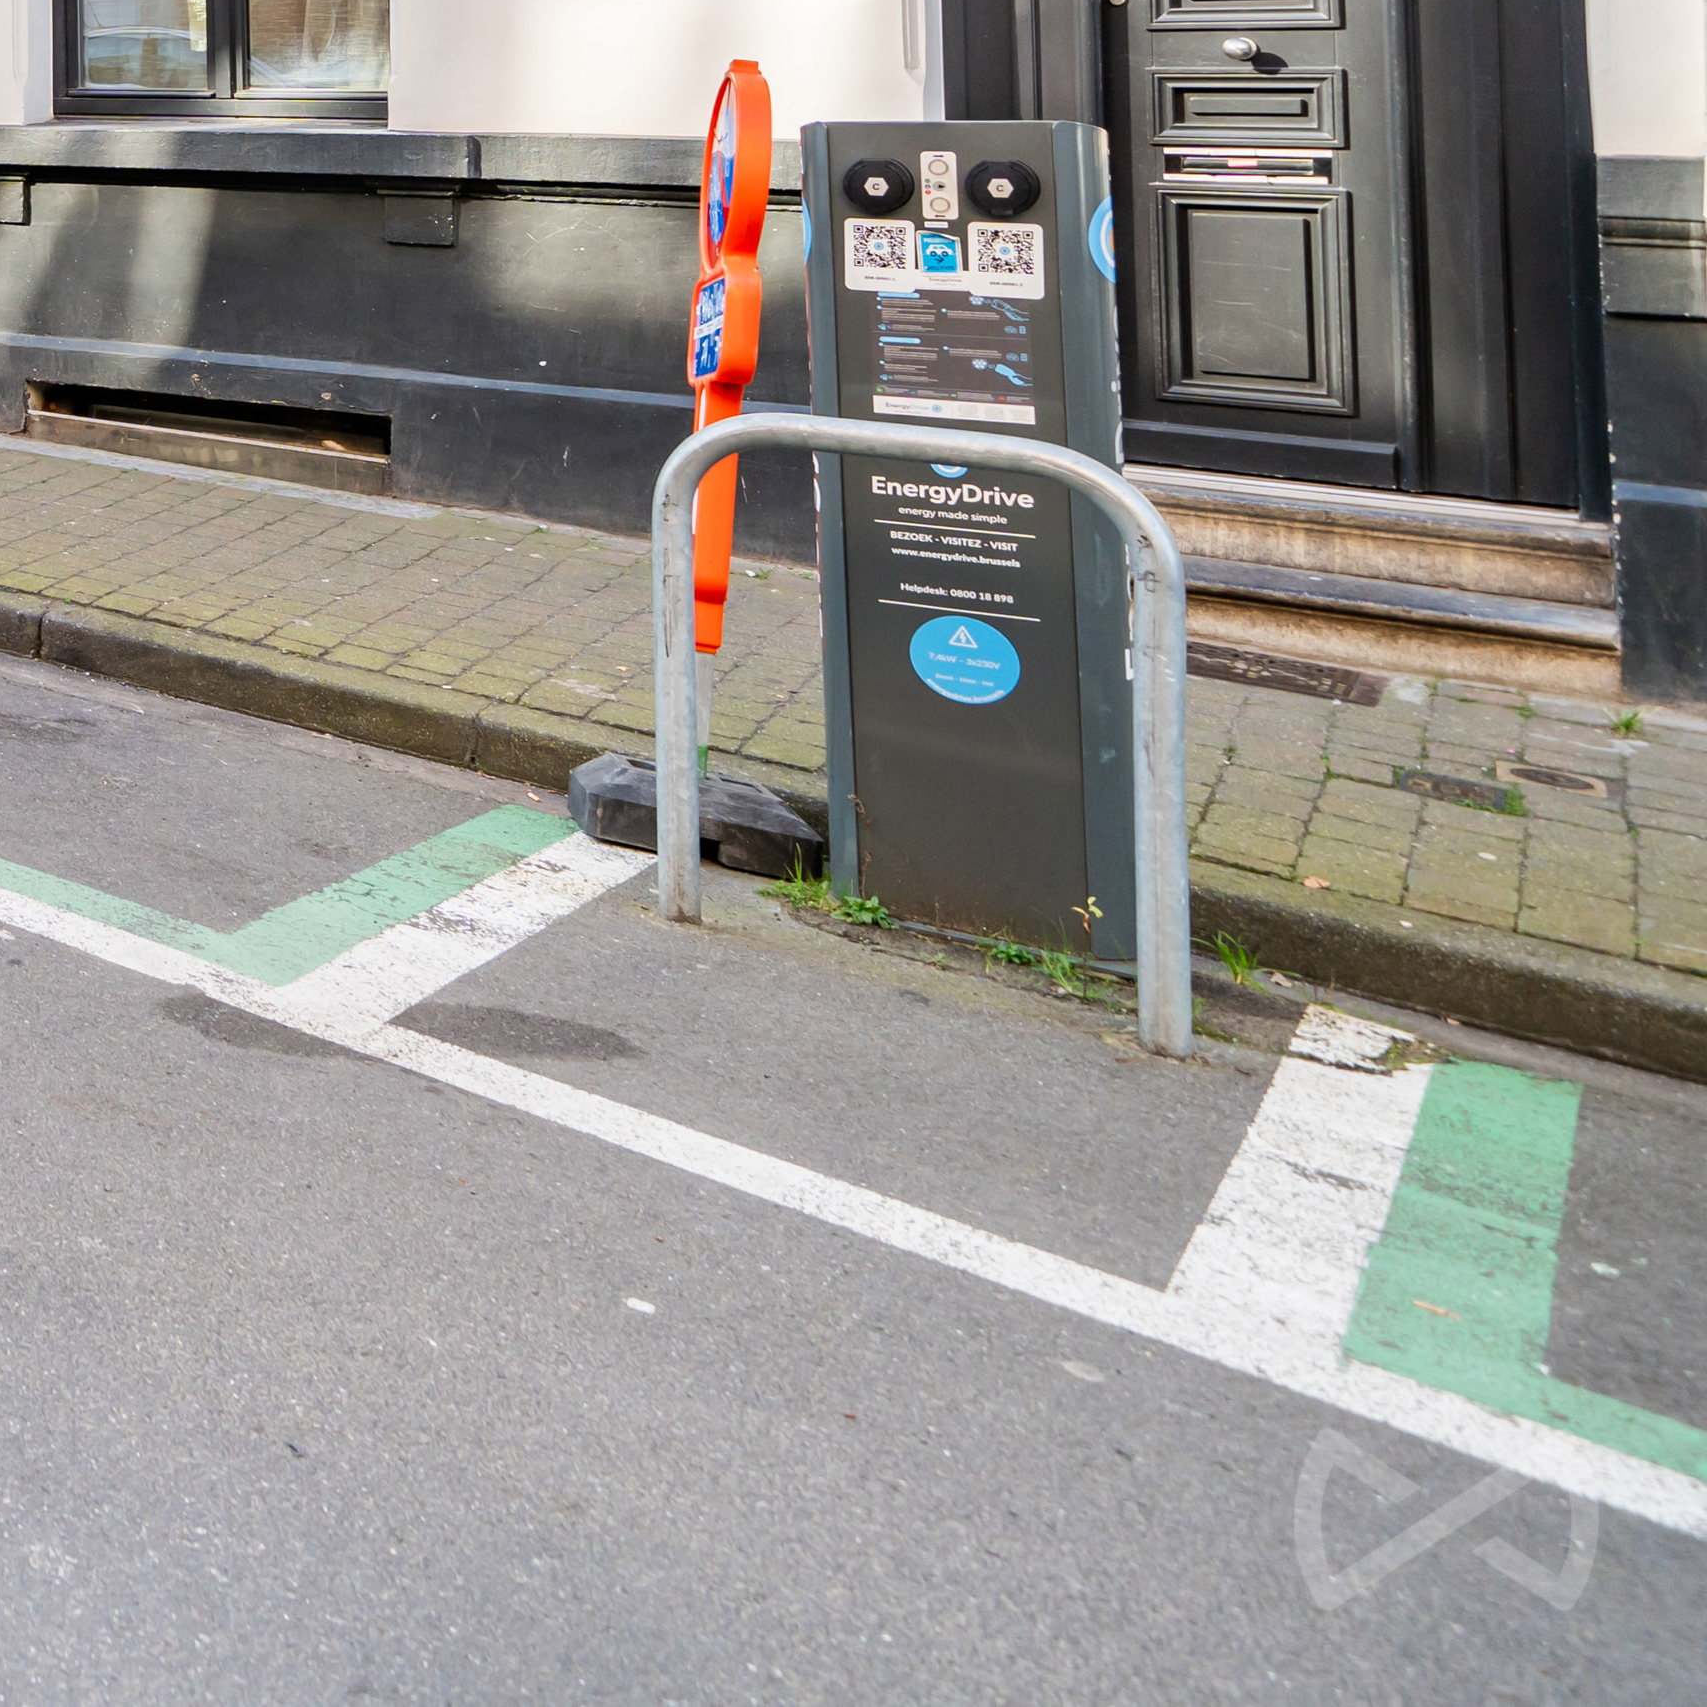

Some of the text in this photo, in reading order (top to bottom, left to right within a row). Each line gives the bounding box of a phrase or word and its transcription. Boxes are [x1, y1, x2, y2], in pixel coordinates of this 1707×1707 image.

[871, 475, 1035, 508] EnergyDrive
[898, 506, 1008, 525] energy made simple
[890, 531, 933, 543] BEZOEK
[940, 536, 982, 548] VISITEZ
[990, 541, 1018, 552] VISIT
[891, 546, 1021, 568] www.energydrive.brussels
[900, 582, 1014, 604] Helpdesk: 0800 18 898
